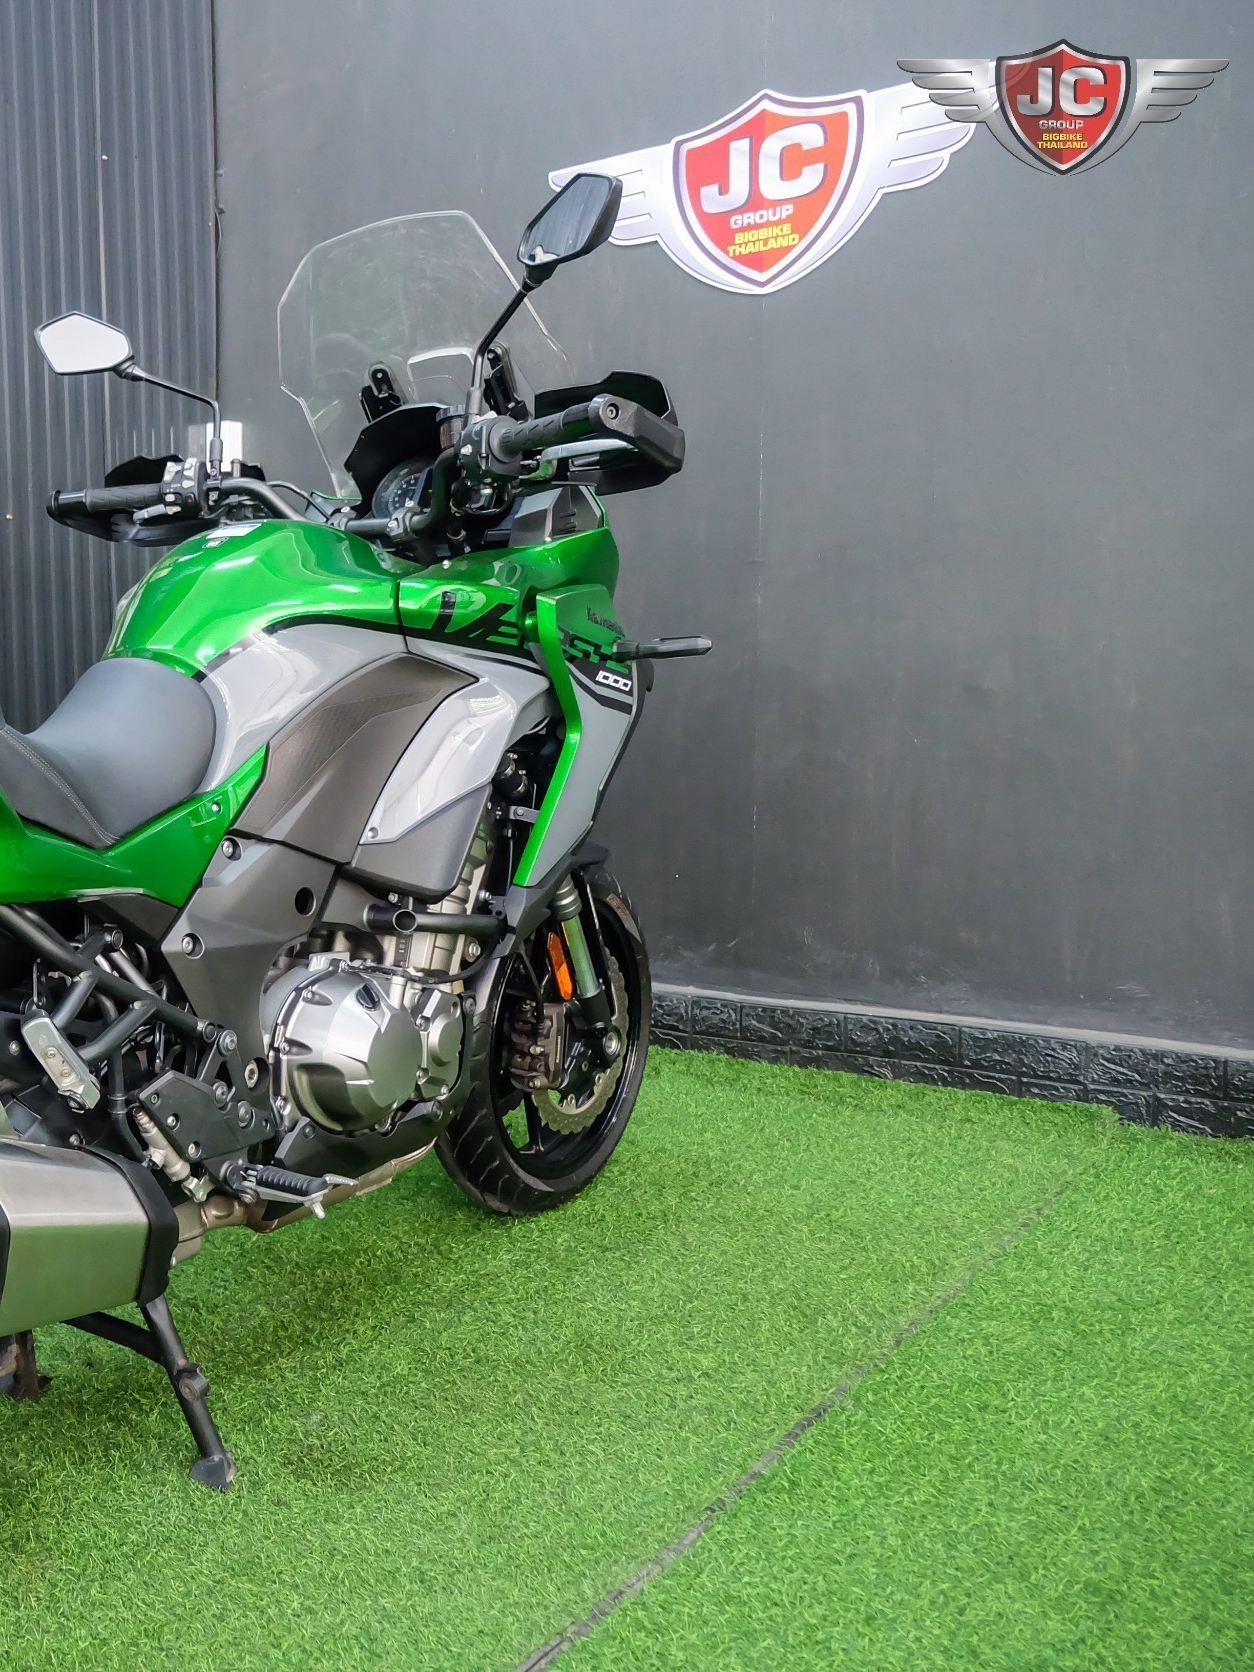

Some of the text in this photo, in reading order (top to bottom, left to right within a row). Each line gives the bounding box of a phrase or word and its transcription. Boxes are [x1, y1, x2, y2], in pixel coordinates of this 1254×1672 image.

[699, 121, 828, 214] JC
[730, 203, 795, 229] GROUP
[726, 233, 800, 258] THAILAND
[734, 222, 793, 245] BIGBIKE
[596, 670, 633, 692] 1000
